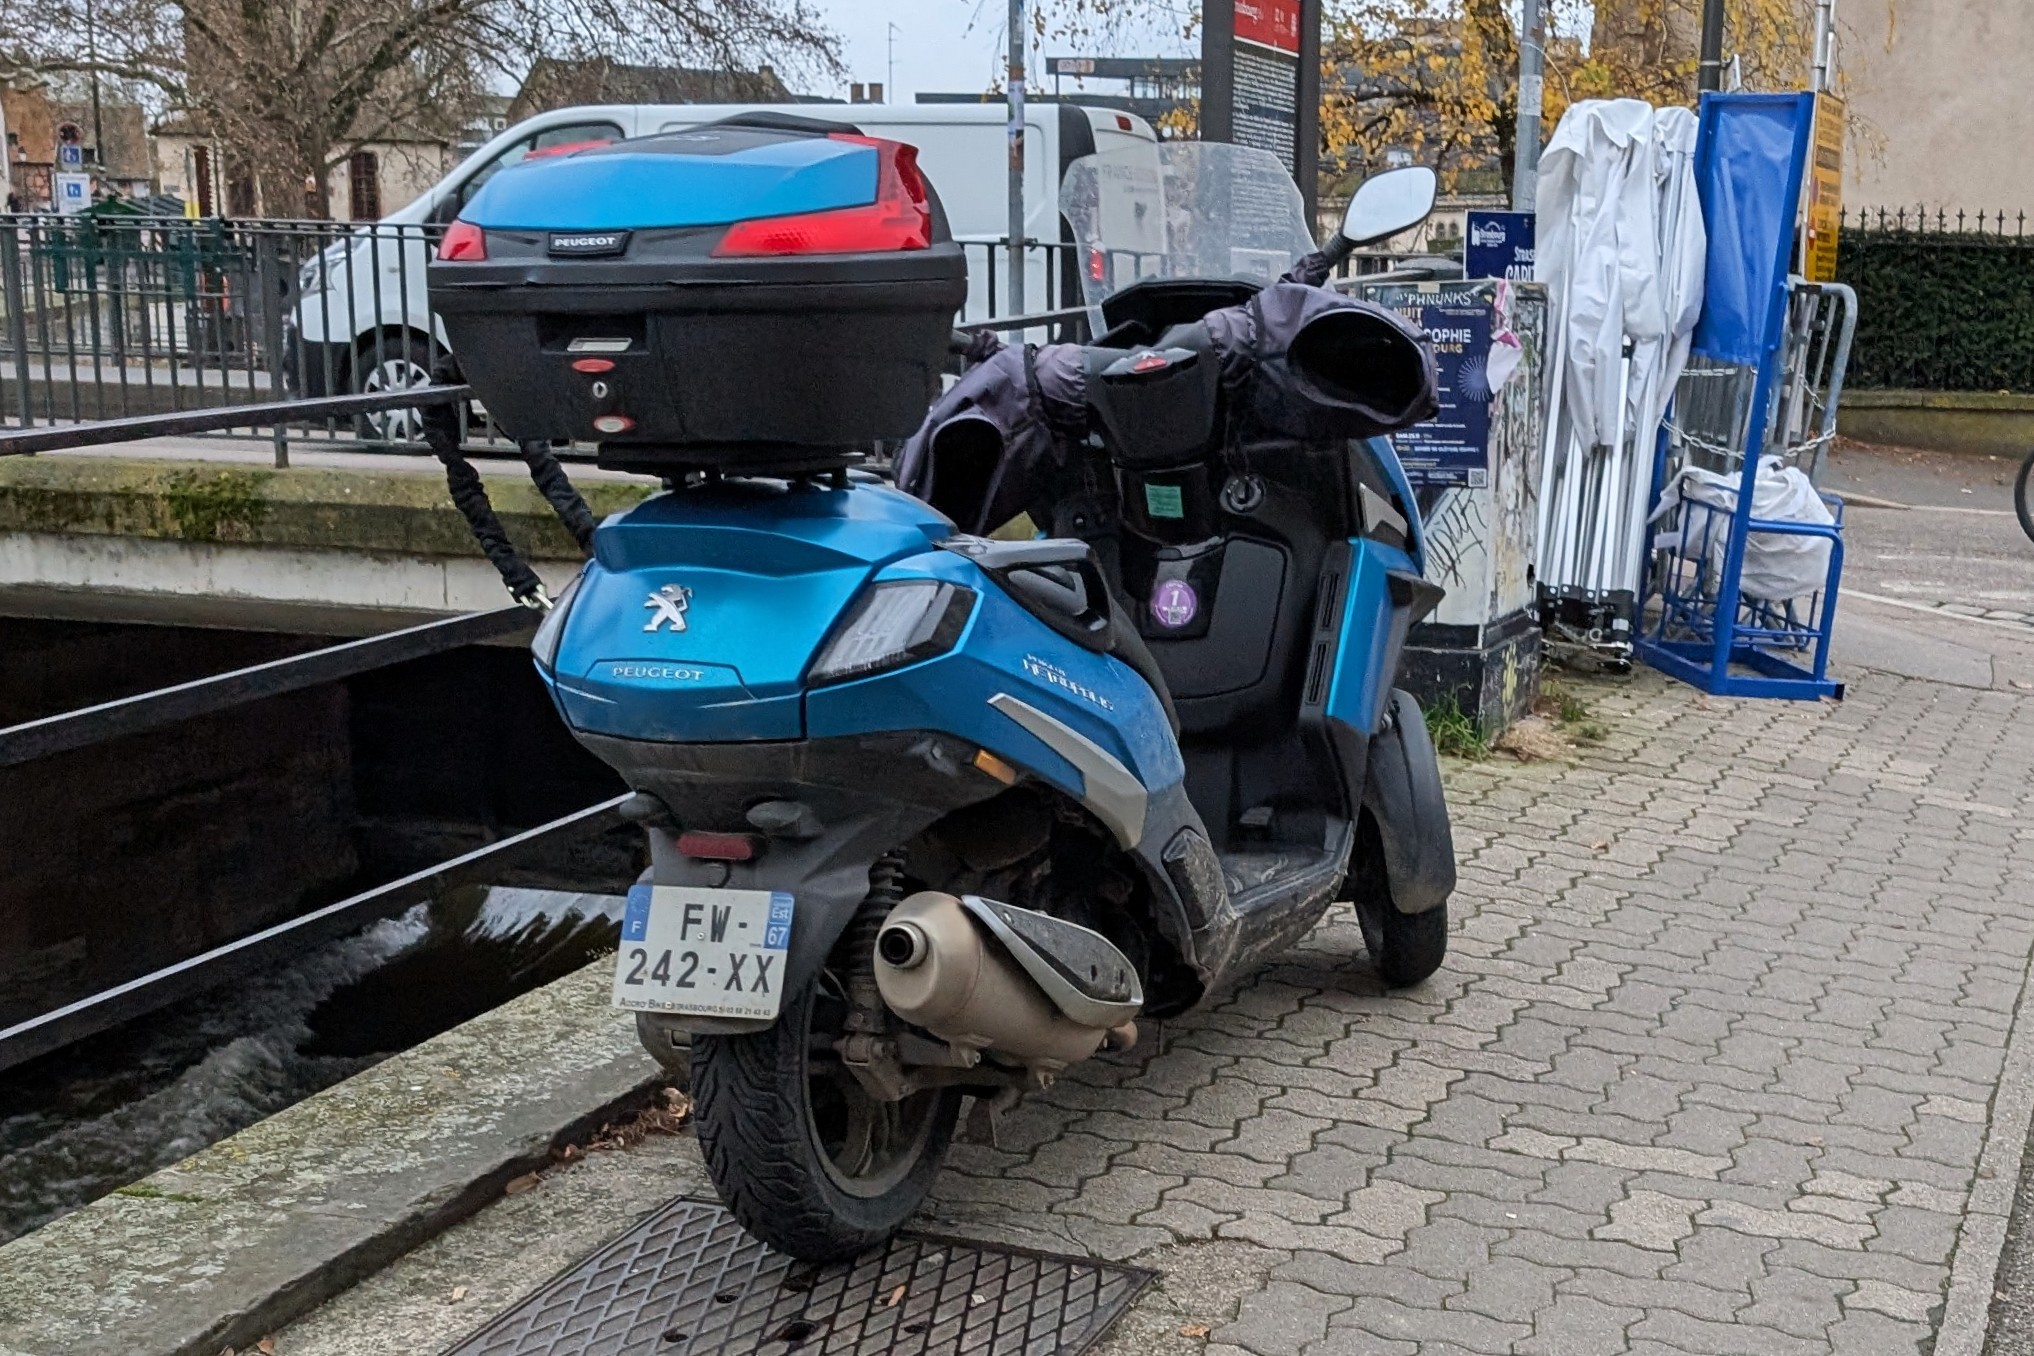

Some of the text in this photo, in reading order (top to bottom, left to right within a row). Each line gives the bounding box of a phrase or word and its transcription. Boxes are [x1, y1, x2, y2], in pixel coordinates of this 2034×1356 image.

[554, 236, 616, 247] PEUGEOT
[1171, 590, 1180, 606] 1
[613, 666, 705, 681] PEUGEOT
[631, 921, 642, 934] F
[680, 903, 748, 943] FW-
[768, 926, 787, 946] 67
[625, 948, 774, 994] 242-XX
